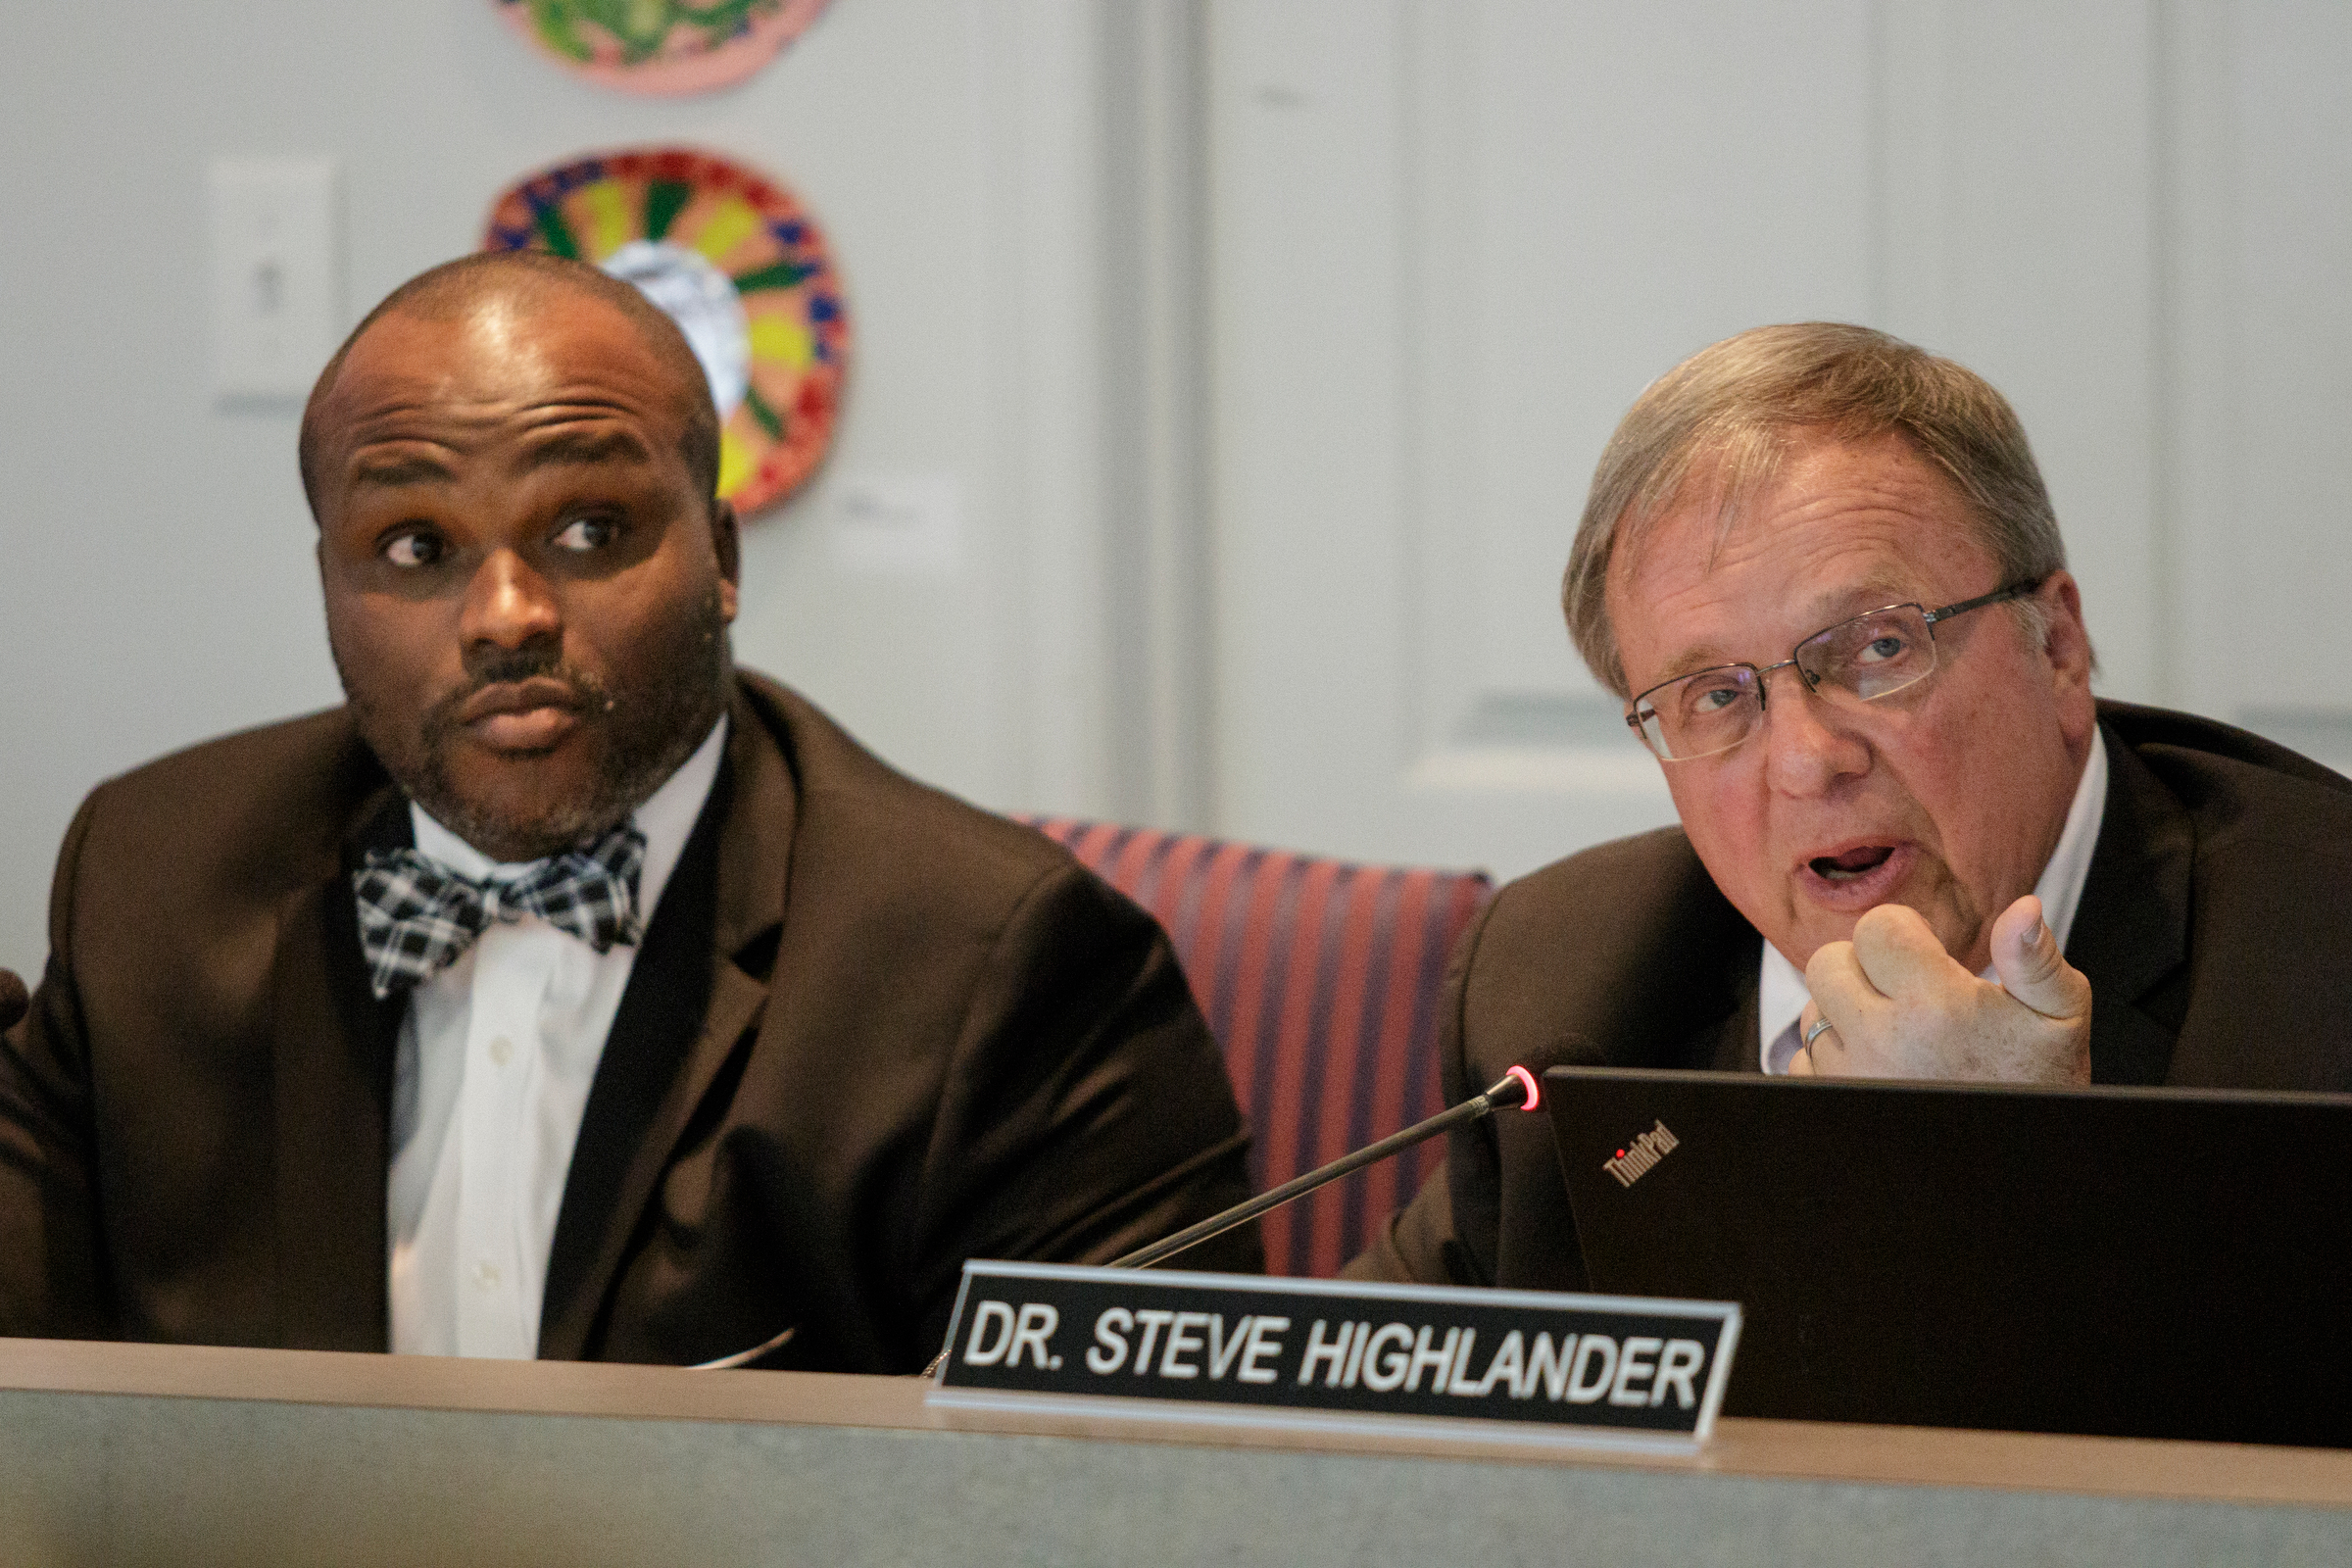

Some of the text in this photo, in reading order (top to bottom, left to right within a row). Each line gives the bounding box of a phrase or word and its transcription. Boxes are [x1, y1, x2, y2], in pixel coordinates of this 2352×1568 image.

[1602, 1118, 1680, 1188] ThinkPad
[964, 1300, 1705, 1407] DR. STEVE HIGHLANDER
